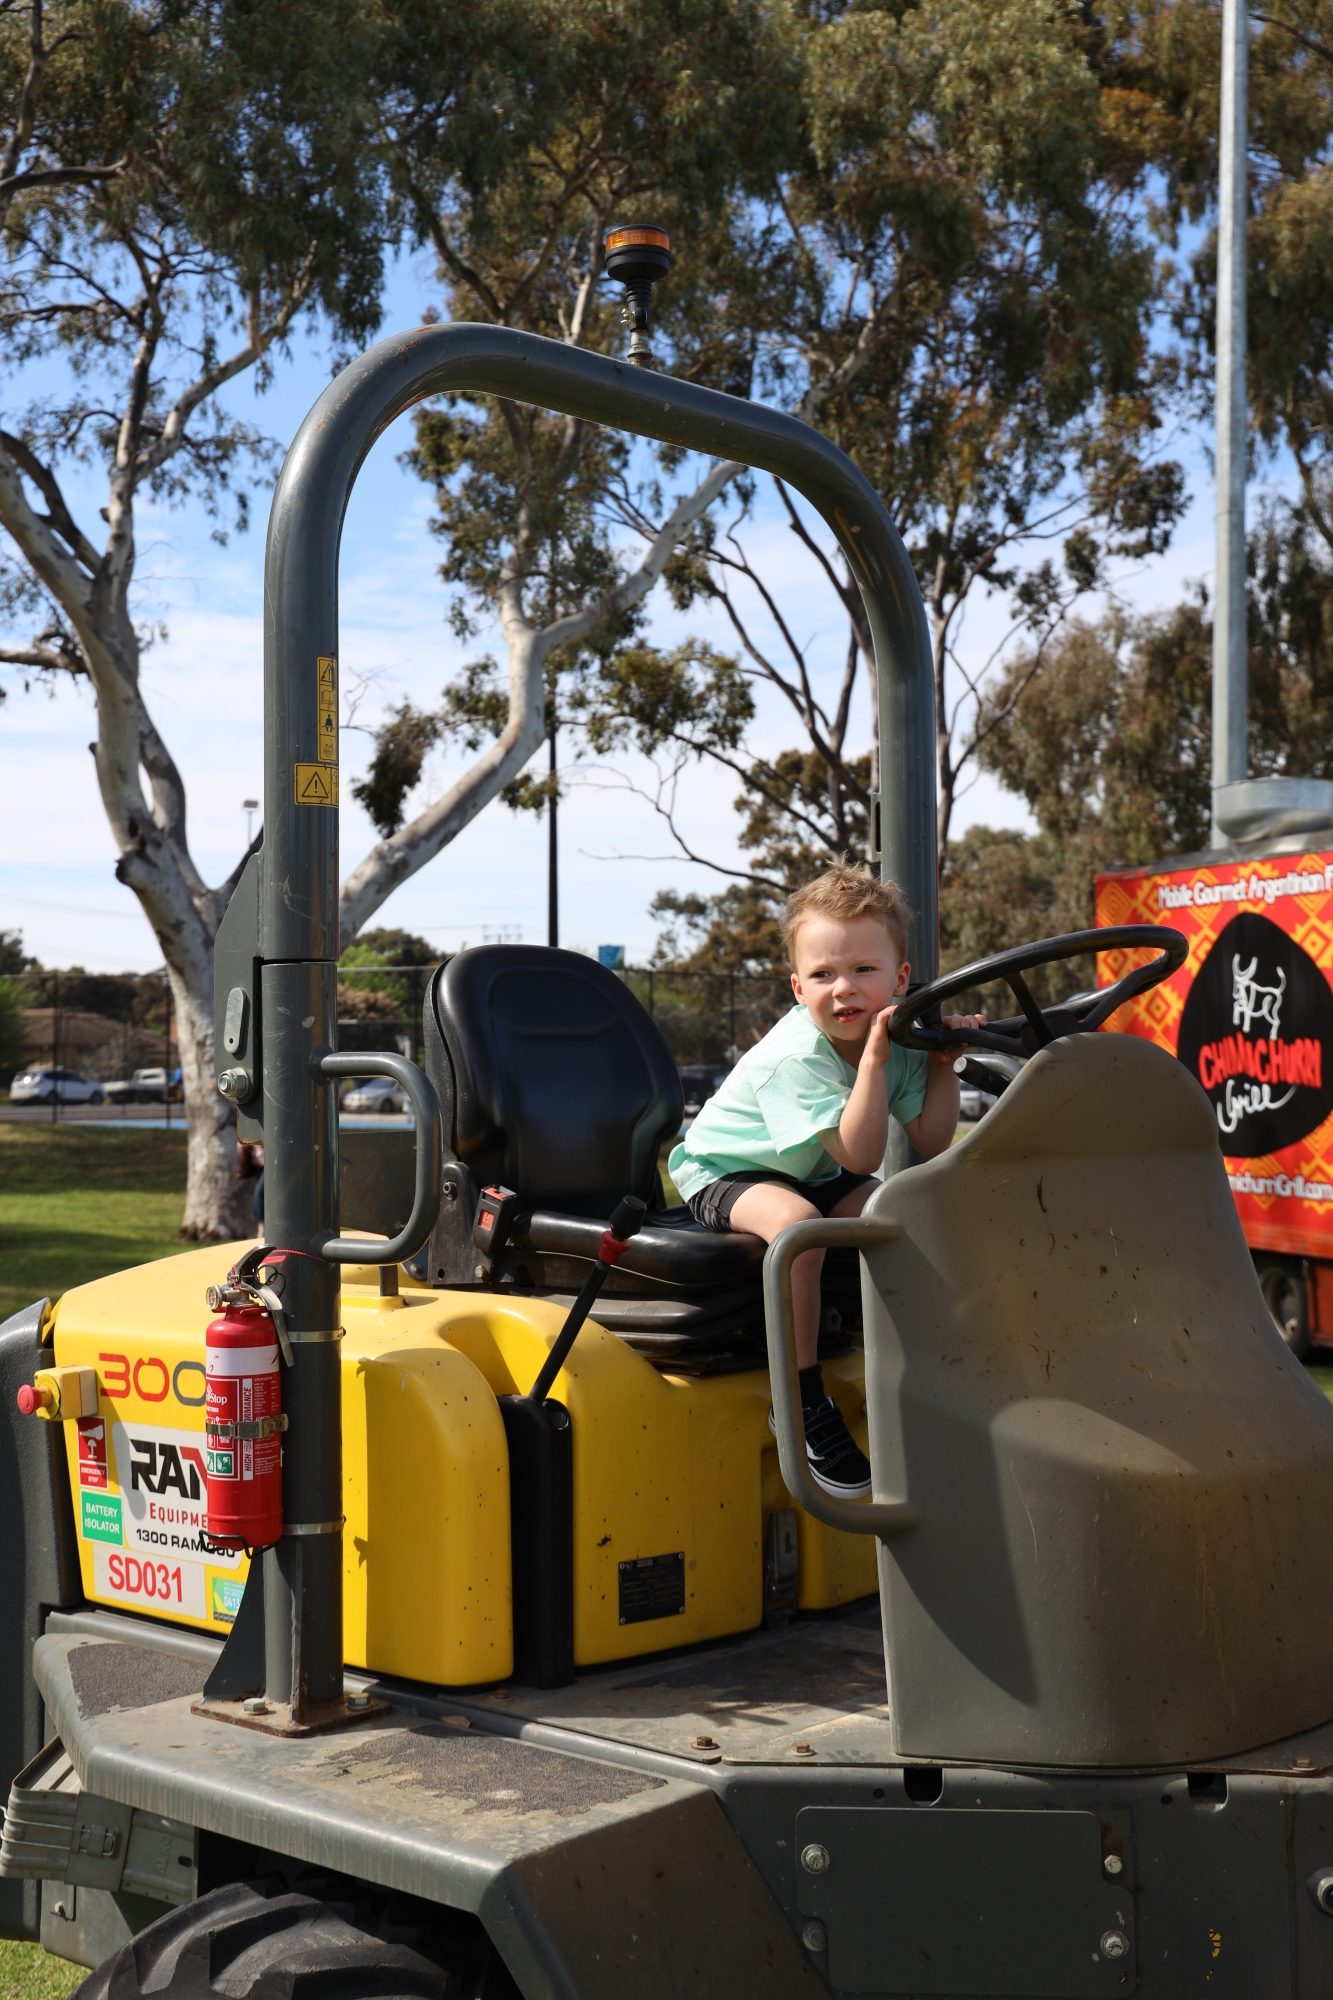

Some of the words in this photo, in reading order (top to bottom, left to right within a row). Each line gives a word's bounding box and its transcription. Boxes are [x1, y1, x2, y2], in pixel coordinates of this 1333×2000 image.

[1158, 883, 1193, 909] Mobile
[1194, 877, 1247, 906] Gourmet
[1248, 871, 1324, 904] Argentinian
[1217, 1078, 1298, 1133] Grill
[244, 1453, 252, 1471] HIGH
[88, 1475, 99, 1483] STOP
[85, 1502, 117, 1519] BATTERY
[84, 1517, 120, 1534] ISOLATOR
[136, 1528, 168, 1546] 1300
[171, 1535, 203, 1552] RAM
[108, 1553, 183, 1603] SD031
